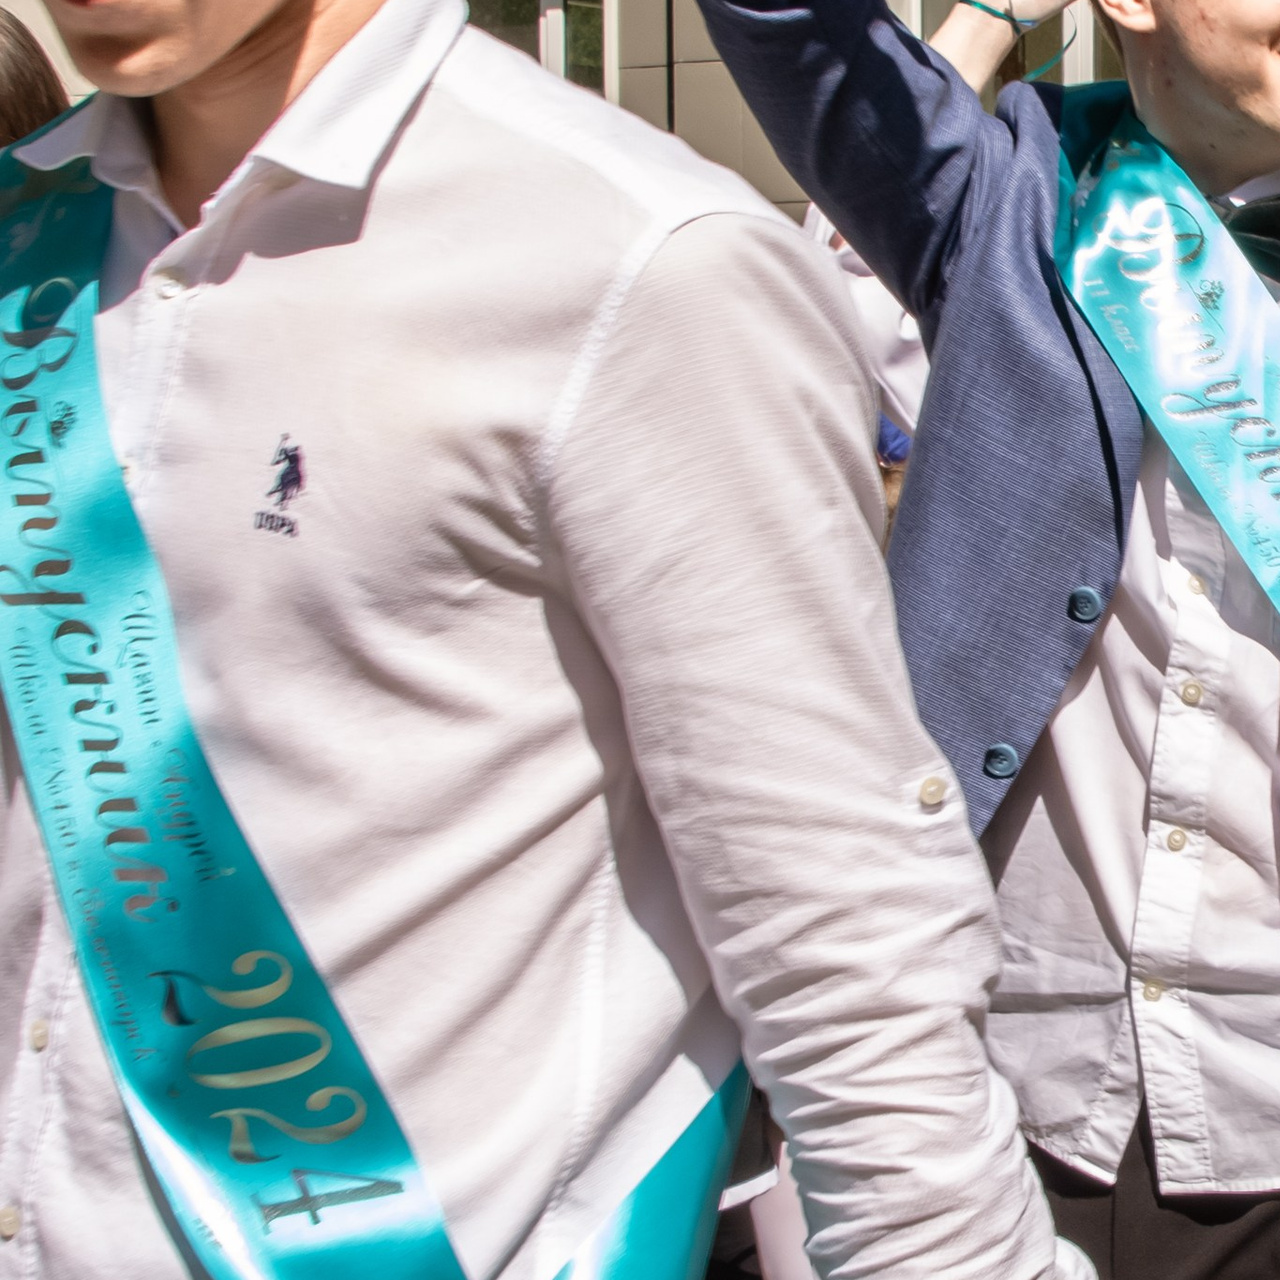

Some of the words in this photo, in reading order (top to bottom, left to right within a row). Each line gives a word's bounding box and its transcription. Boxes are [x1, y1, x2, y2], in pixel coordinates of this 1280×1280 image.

[1101, 304, 1140, 354] класс
[0, 276, 180, 923] Выпускник
[149, 948, 404, 1236] 2024
